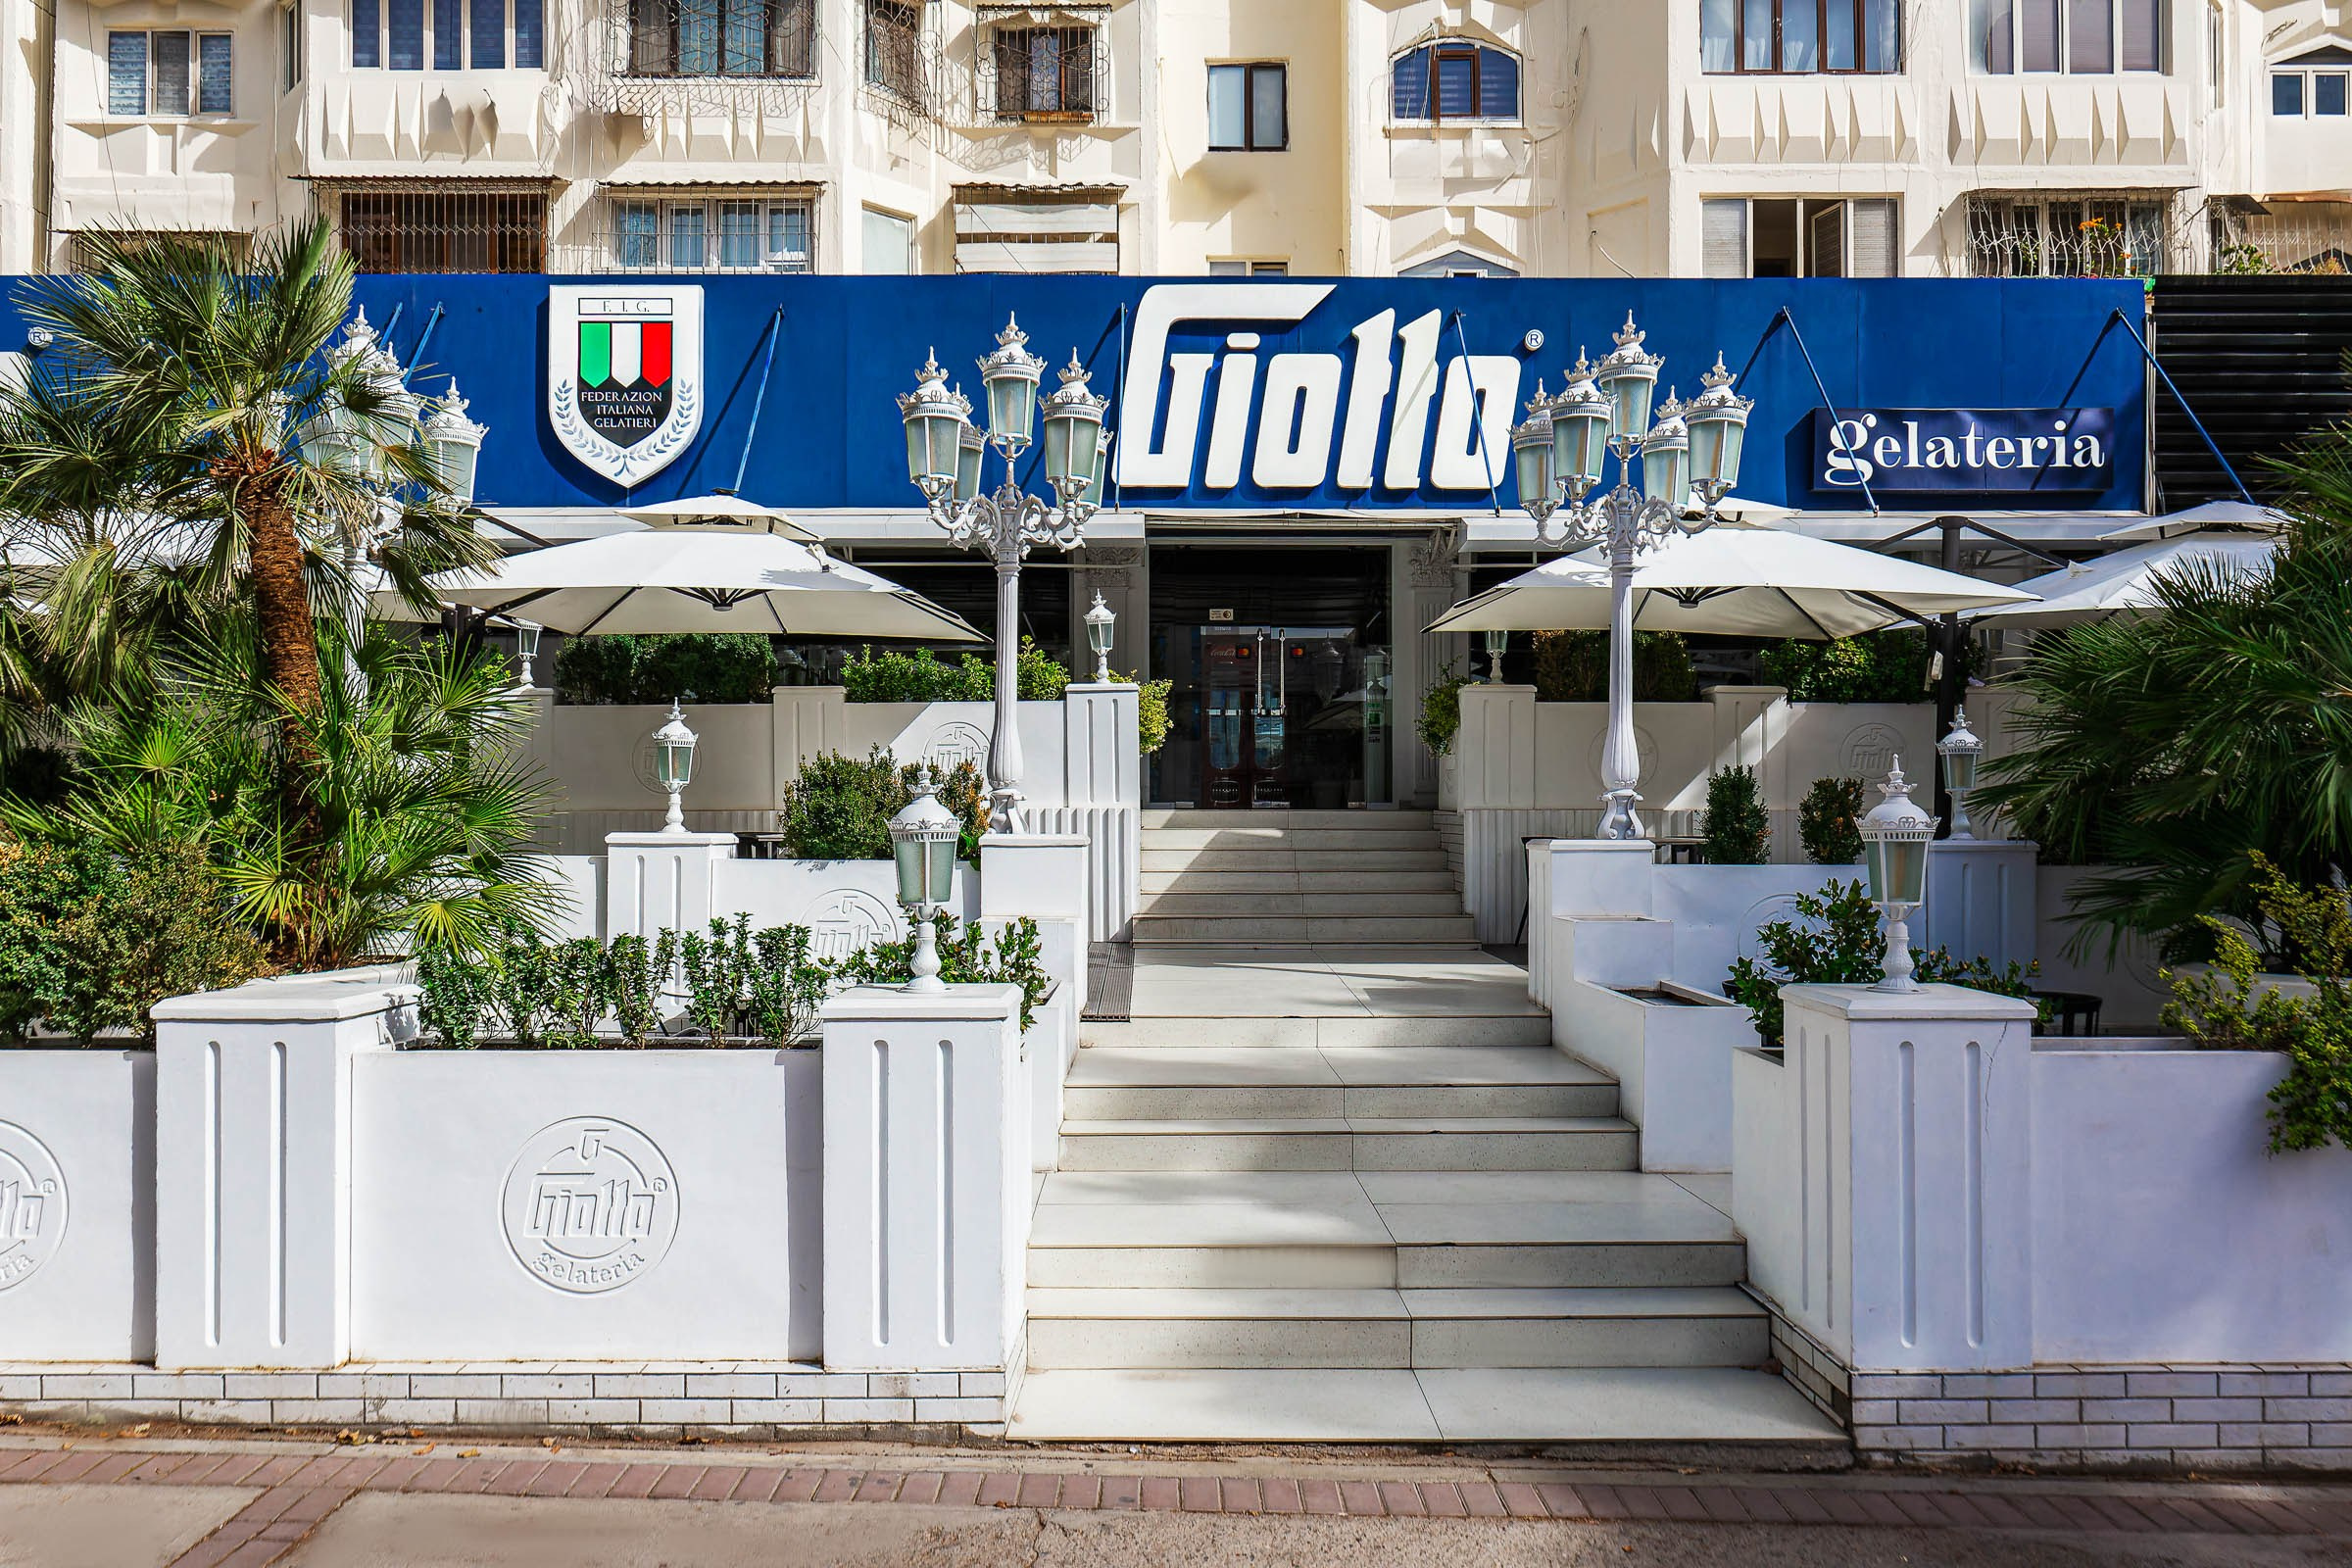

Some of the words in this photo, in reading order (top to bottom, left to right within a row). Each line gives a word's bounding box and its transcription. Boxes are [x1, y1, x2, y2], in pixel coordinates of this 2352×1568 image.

[581, 391, 662, 403] FEDERAZION
[1111, 283, 1521, 489] Giotto
[597, 404, 654, 416] ITALIANA
[594, 416, 657, 429] GELATIERI
[1824, 413, 2105, 486] gelateria
[532, 1251, 646, 1285] gelateria
